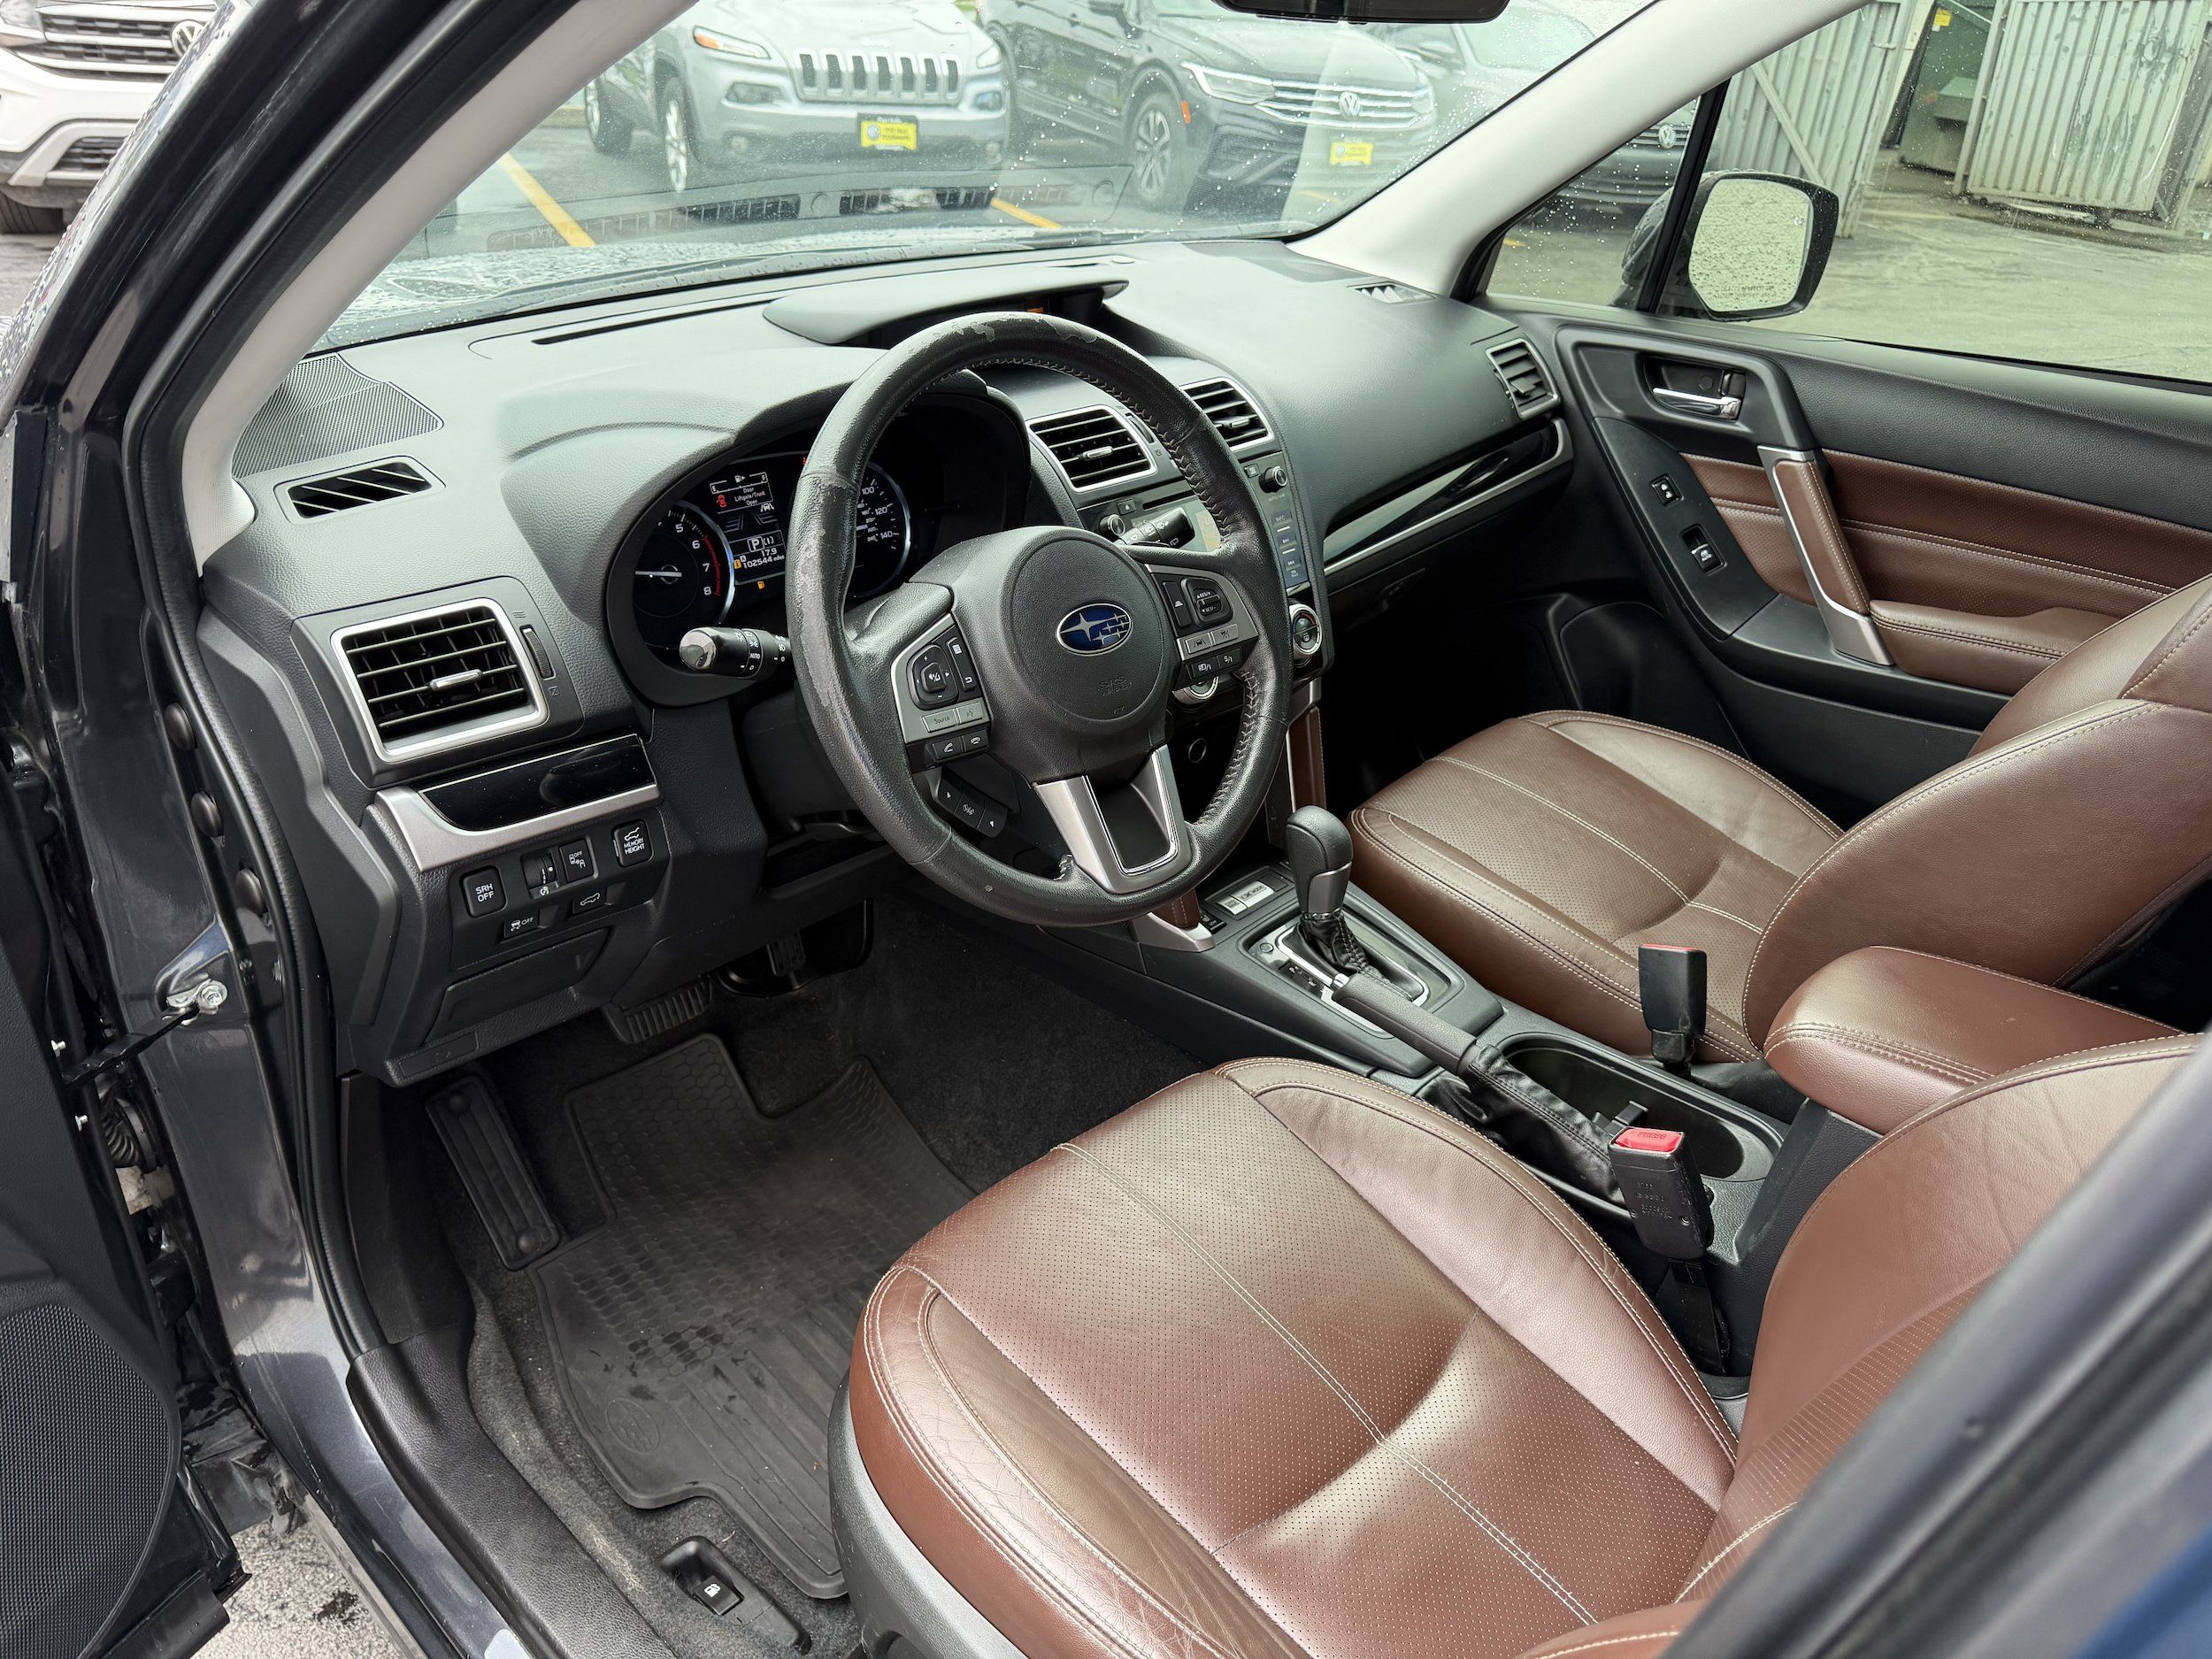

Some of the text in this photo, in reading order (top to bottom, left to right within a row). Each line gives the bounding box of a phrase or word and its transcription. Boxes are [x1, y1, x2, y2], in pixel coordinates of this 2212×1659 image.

[861, 486, 874, 495] 100
[874, 506, 887, 515] 120
[675, 523, 684, 533] 5
[879, 530, 893, 539] 140
[692, 540, 700, 549] 6
[751, 539, 760, 549] P
[761, 547, 778, 557] 17.9
[703, 563, 710, 572] 7
[742, 556, 772, 569] 102544
[703, 586, 711, 595] 8
[933, 715, 950, 725] Source
[624, 837, 644, 849] MEMORY
[624, 843, 645, 855] HEIGHT
[475, 884, 493, 895] SRH
[478, 891, 495, 902] OFF
[521, 916, 534, 926] OFF
